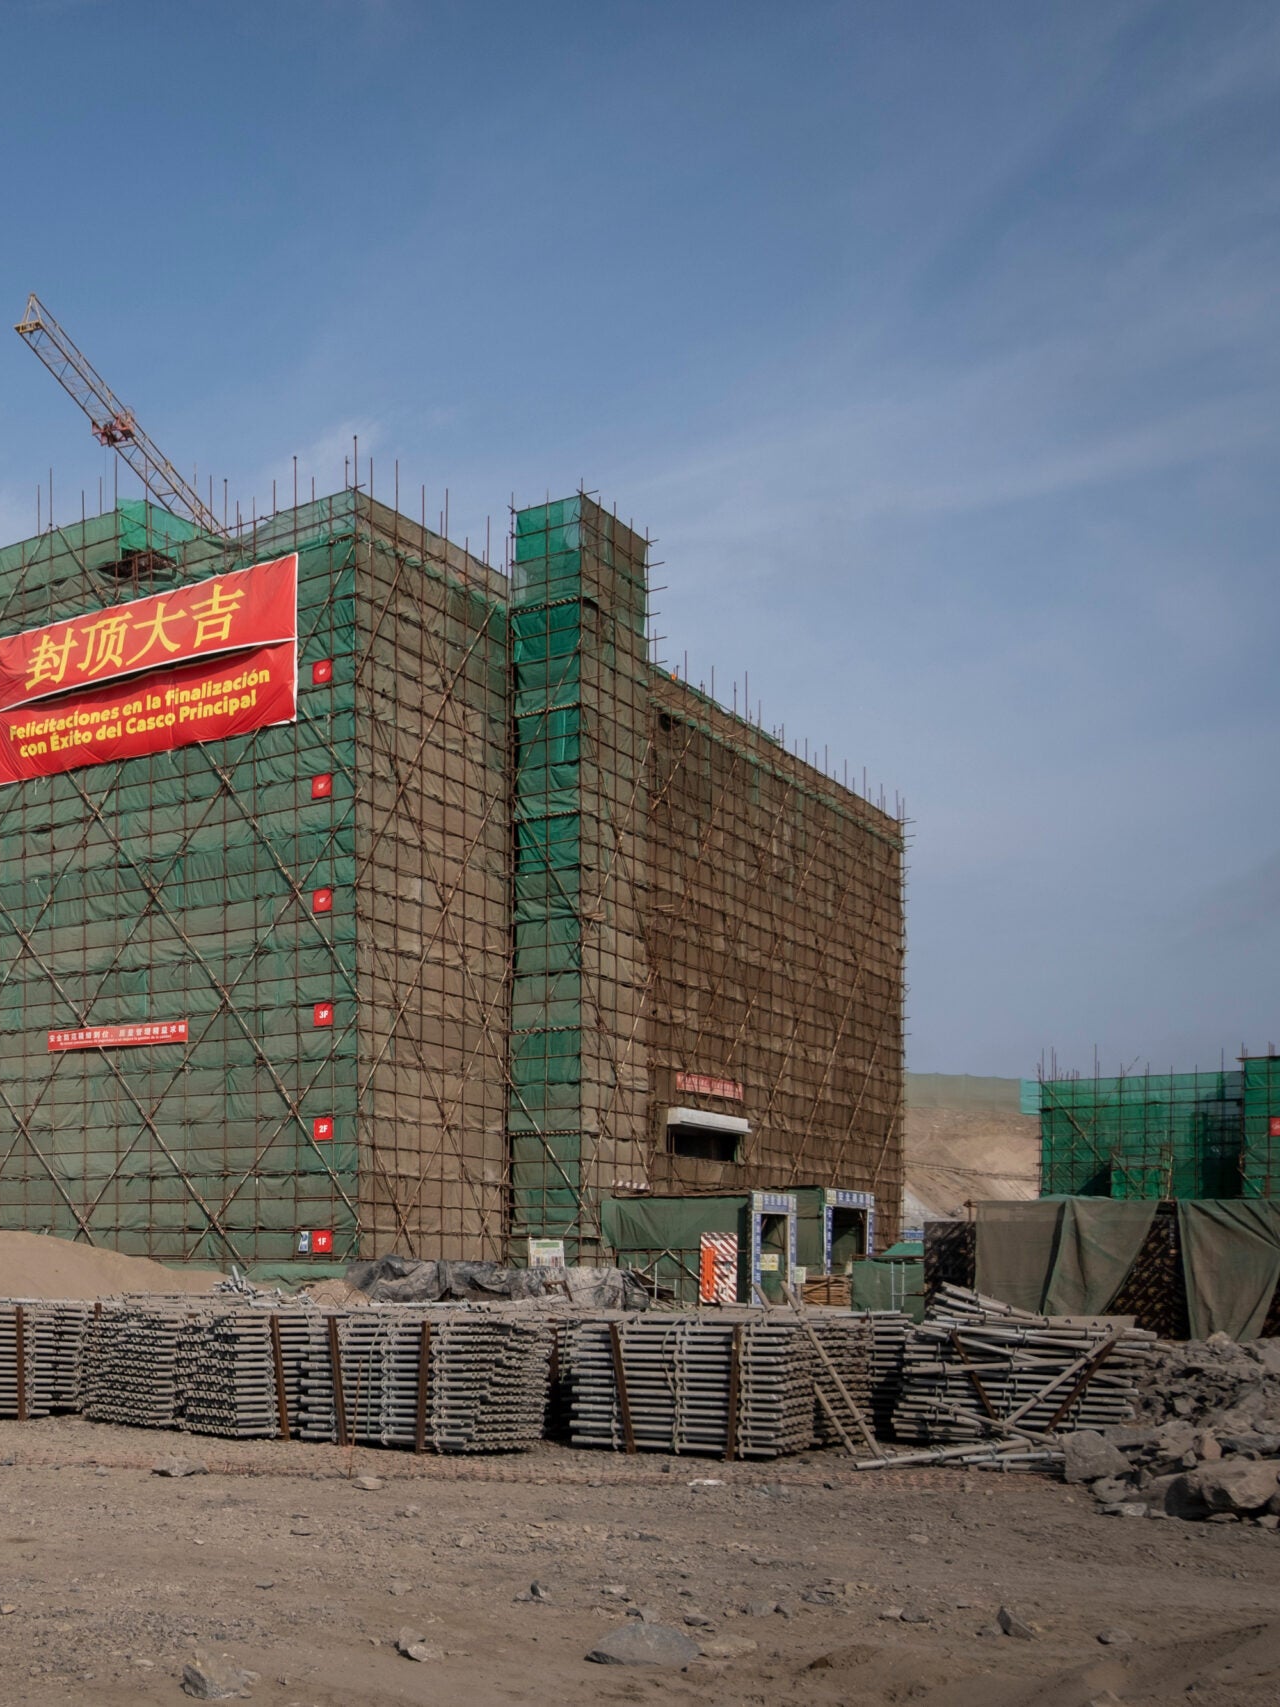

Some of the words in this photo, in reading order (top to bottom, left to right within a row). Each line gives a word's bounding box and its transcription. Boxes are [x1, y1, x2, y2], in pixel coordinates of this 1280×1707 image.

[25, 584, 245, 691] 封顶大吉
[9, 706, 120, 741] Felicitaciones
[122, 701, 142, 716] en
[146, 695, 161, 710] la
[20, 741, 47, 758] con
[50, 729, 92, 751] Éxito
[95, 721, 122, 741] del
[125, 712, 175, 734] Casco
[179, 689, 256, 723] Principal
[319, 1010, 328, 1019] 3F
[319, 1125, 328, 1133] 2F
[318, 1237, 327, 1245] 1F
